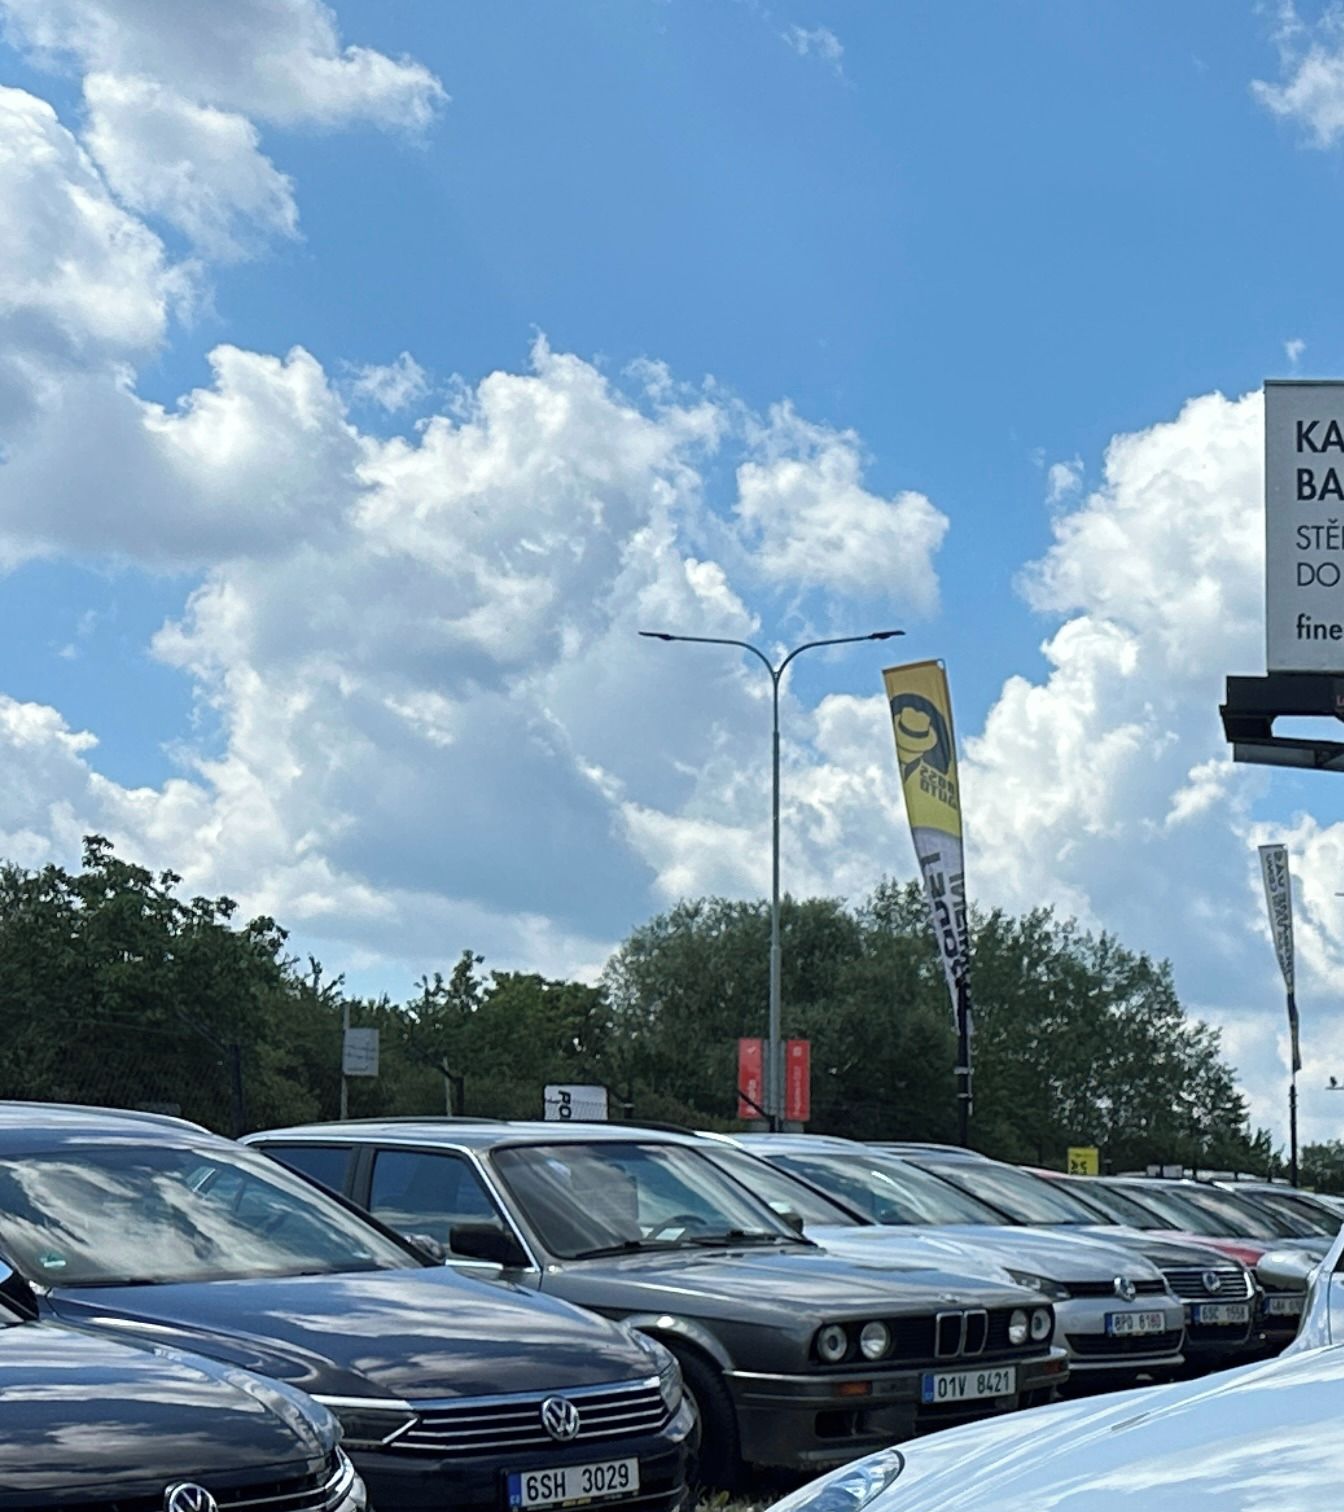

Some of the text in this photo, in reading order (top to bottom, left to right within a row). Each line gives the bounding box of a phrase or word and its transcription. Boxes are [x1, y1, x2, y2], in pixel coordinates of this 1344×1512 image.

[1296, 562, 1341, 587] DO
[938, 1370, 1009, 1398] 01V 8421
[526, 1463, 629, 1501] 6SH 3029
